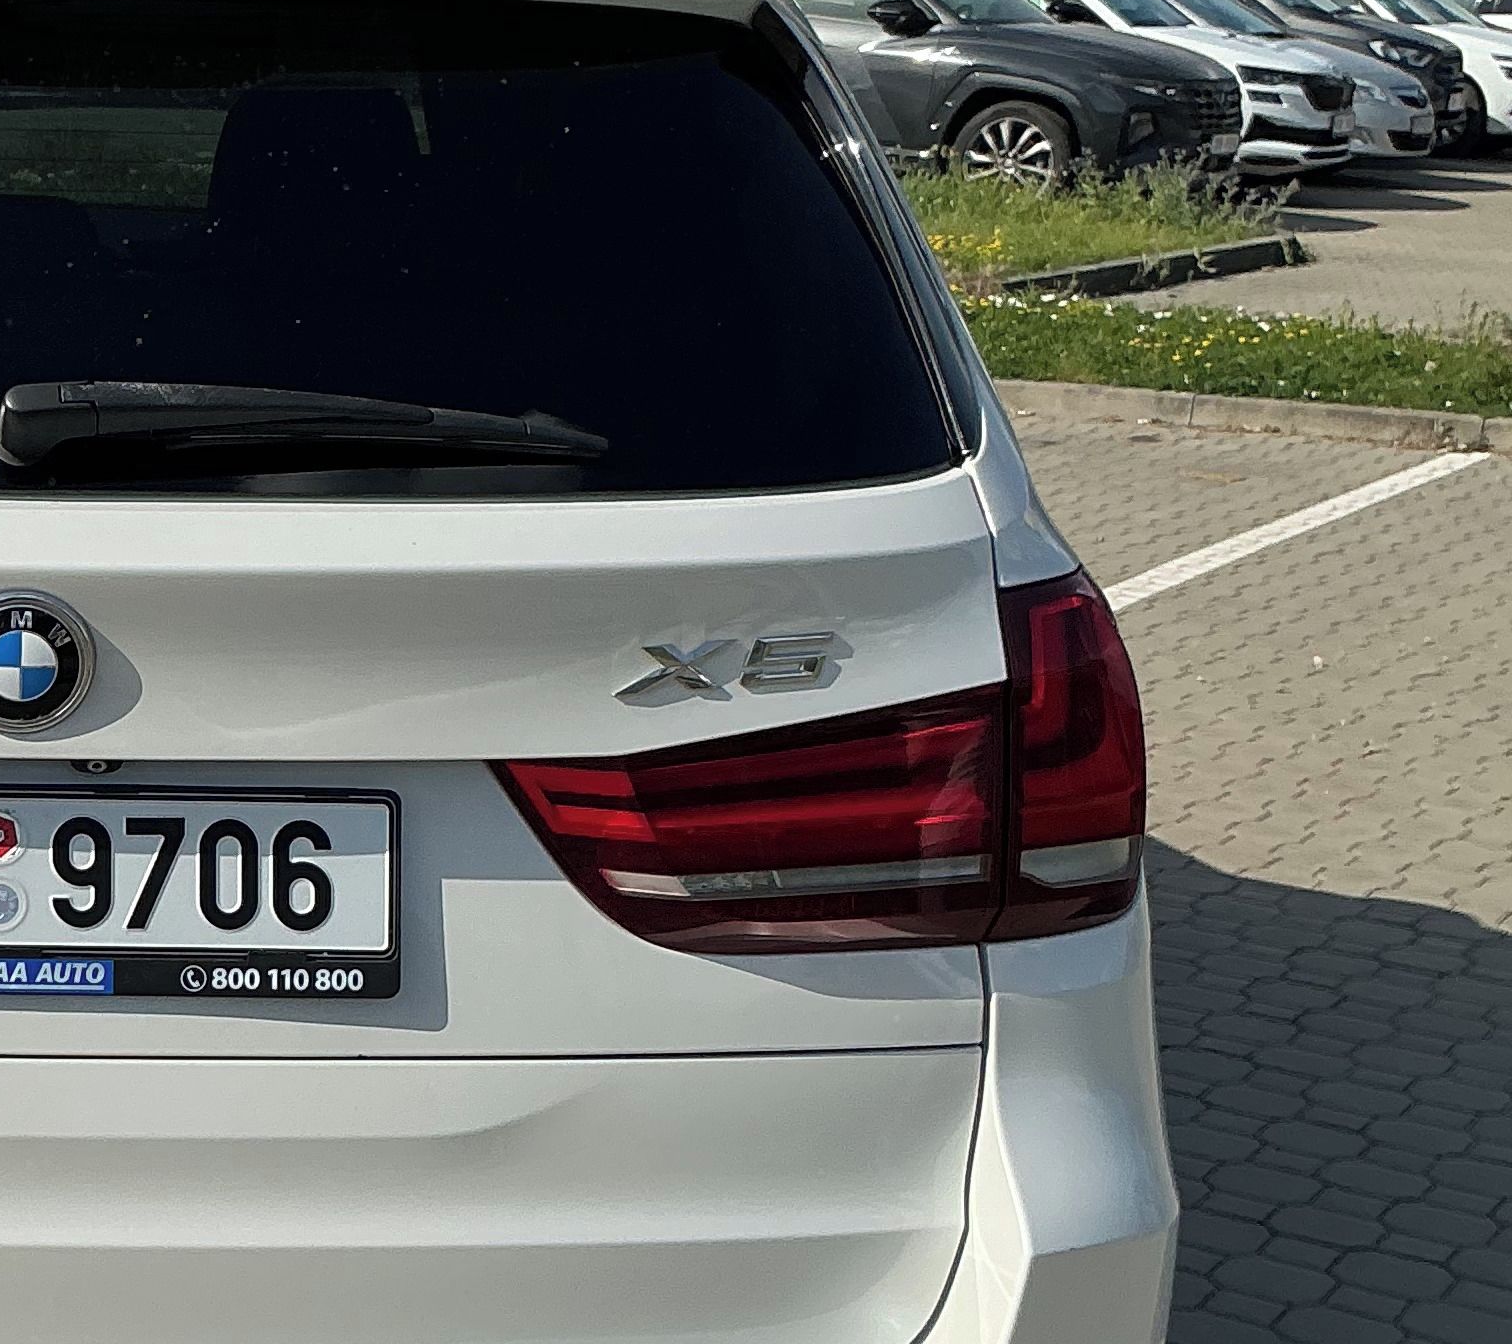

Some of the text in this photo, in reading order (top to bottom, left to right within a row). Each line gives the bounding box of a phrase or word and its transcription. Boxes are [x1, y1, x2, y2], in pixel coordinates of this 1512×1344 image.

[611, 631, 836, 696] X5
[51, 816, 334, 932] 9706
[34, 962, 105, 985] AUTO
[212, 966, 364, 992] 800 110 800
